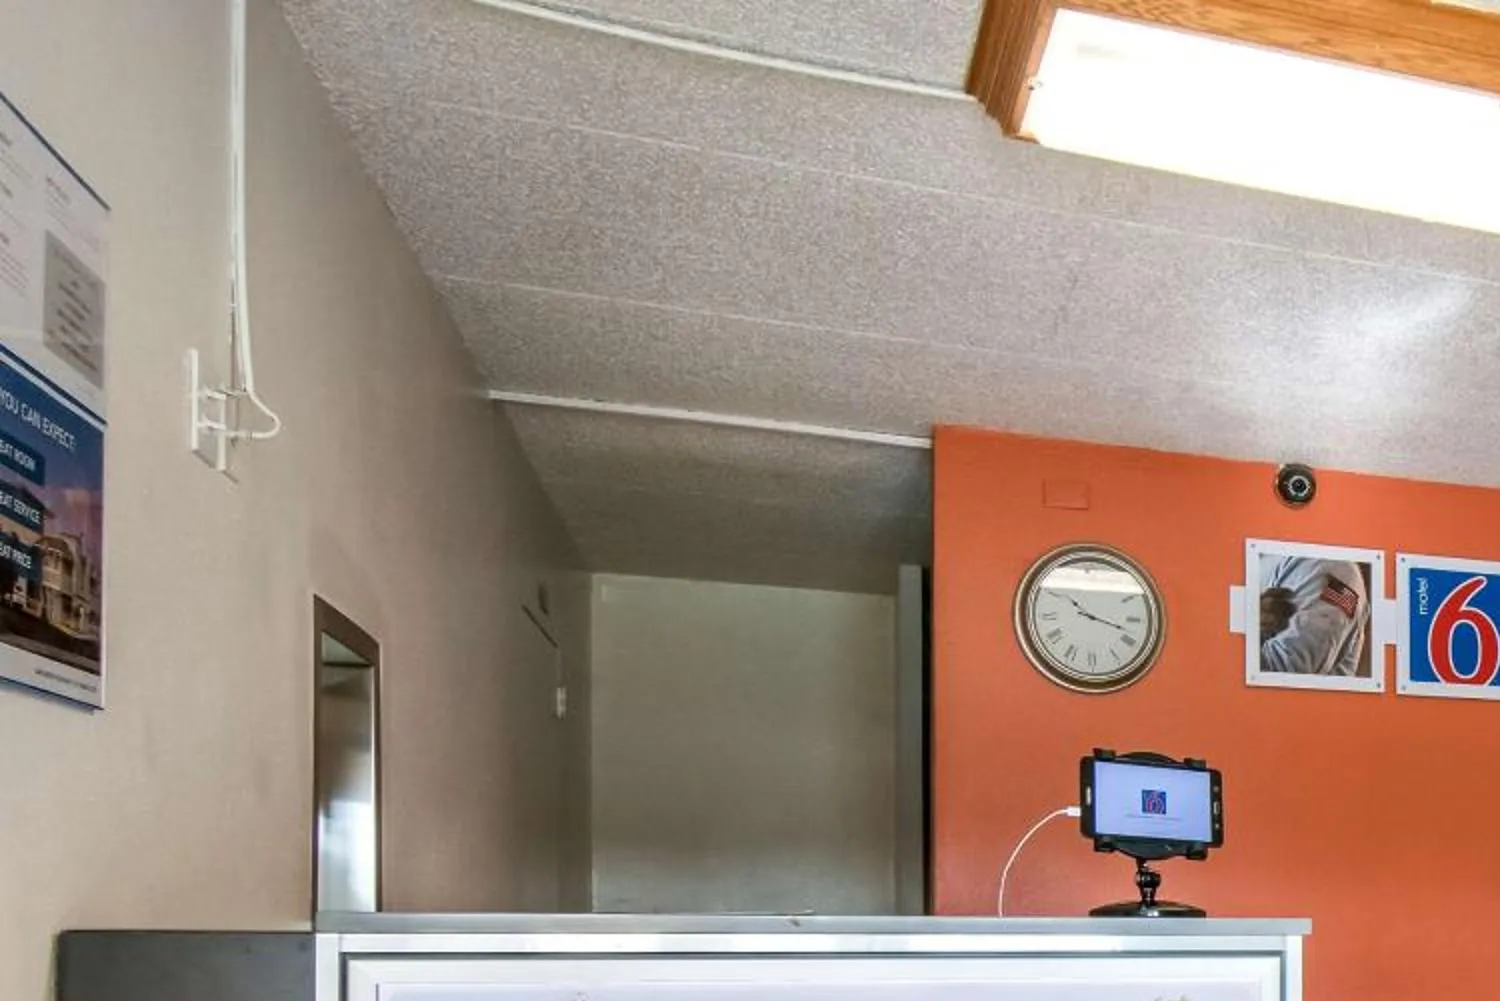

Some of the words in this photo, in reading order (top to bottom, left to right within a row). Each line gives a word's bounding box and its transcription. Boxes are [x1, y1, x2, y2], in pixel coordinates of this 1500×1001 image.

[21, 403, 41, 429] CAN
[14, 447, 36, 472] ROOM
[14, 499, 41, 525] SERVICE
[1416, 576, 1429, 616] motel
